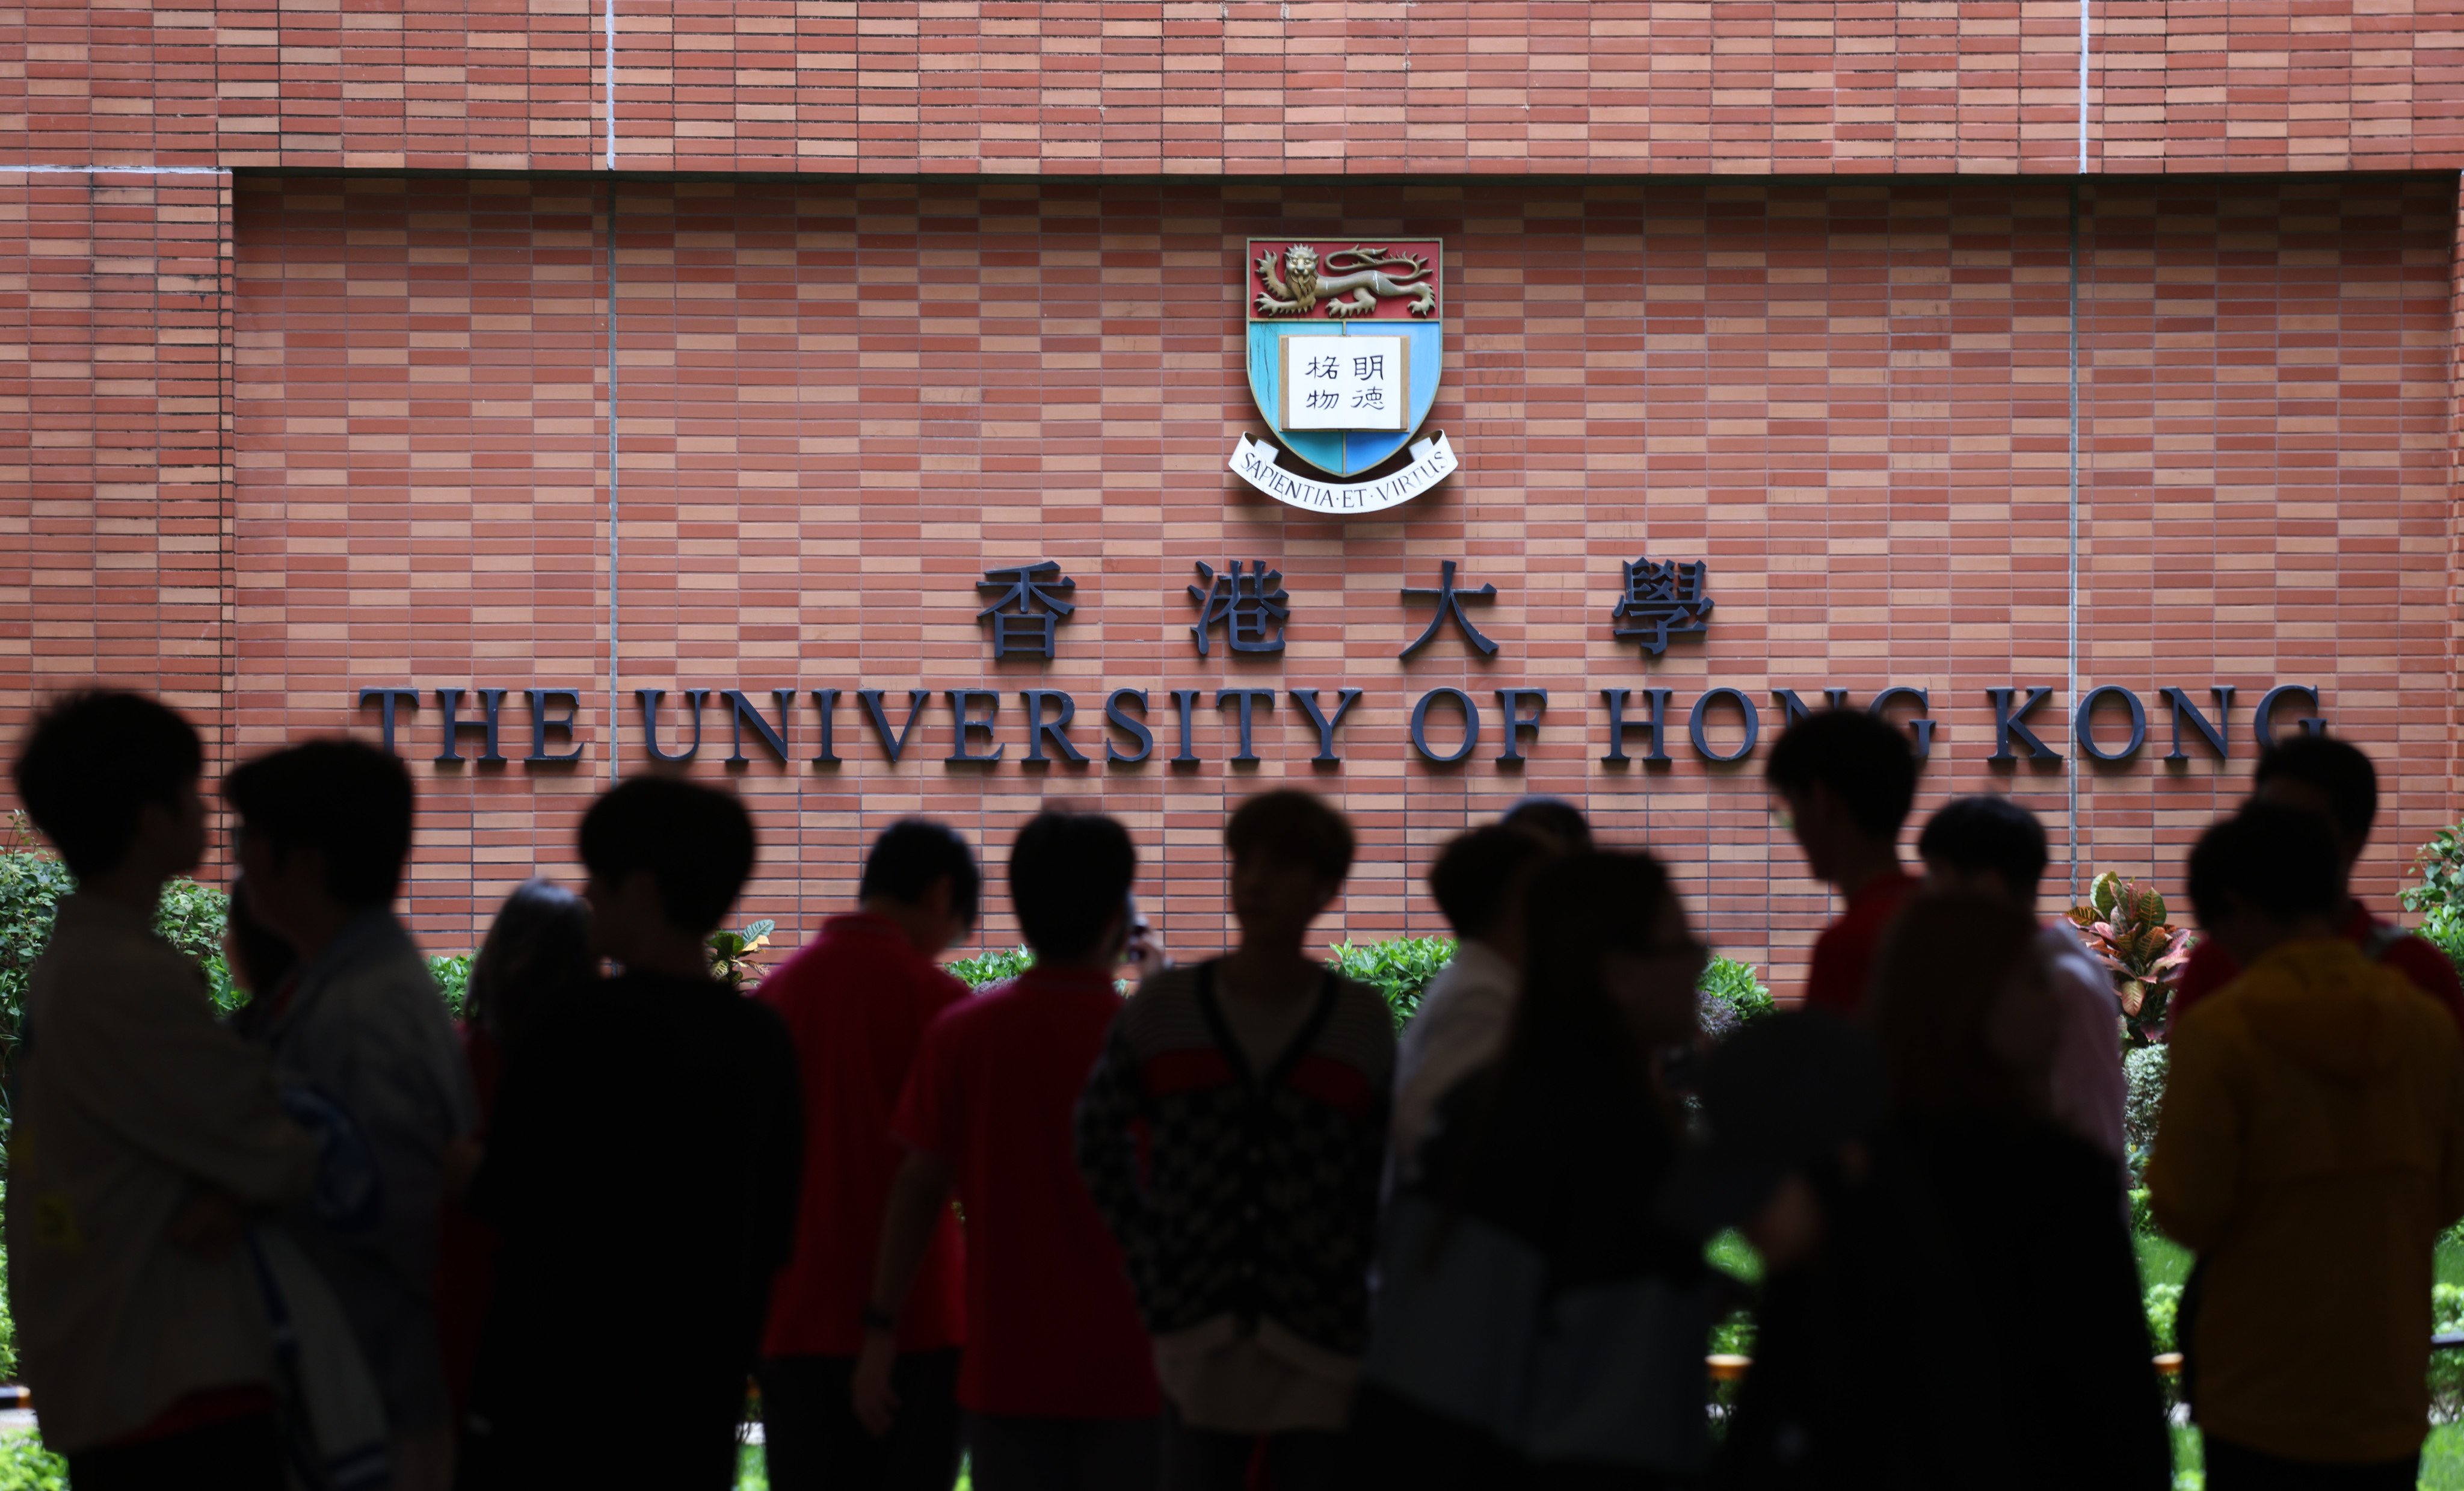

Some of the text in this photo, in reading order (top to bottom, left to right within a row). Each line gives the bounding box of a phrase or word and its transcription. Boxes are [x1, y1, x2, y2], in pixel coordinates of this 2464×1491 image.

[1375, 451, 1449, 501] VIRTUS
[975, 557, 1715, 658] 香港大學
[359, 687, 585, 762] THE
[635, 687, 1363, 763] UNIVERSITY
[1410, 686, 1548, 761] OF
